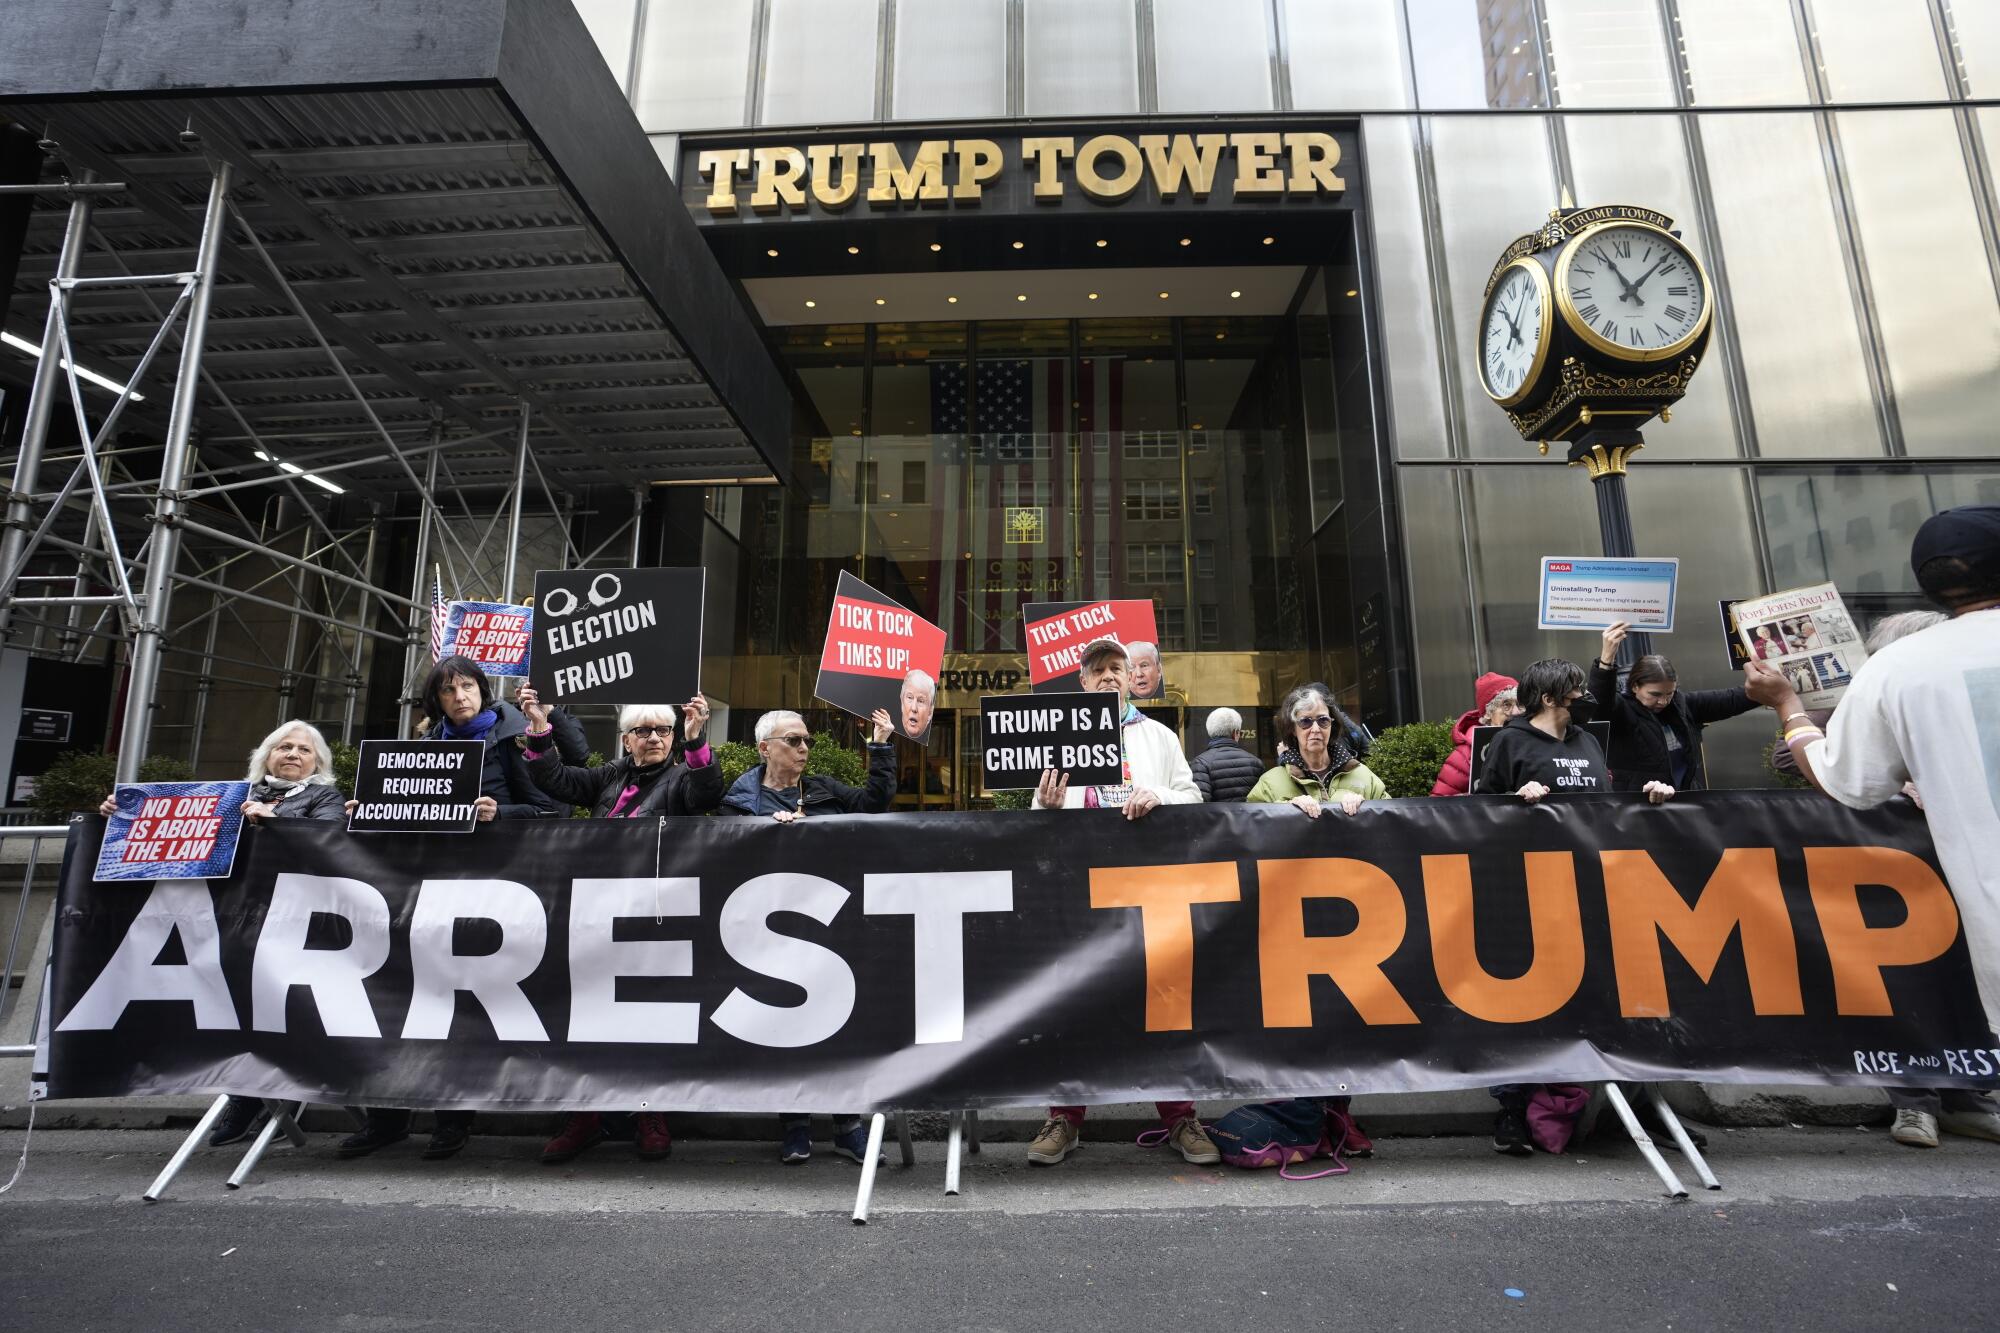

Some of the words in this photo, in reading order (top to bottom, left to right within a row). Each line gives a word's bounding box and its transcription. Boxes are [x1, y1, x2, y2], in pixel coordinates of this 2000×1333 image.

[699, 139, 1003, 215] TRUMP
[1022, 132, 1346, 203] TOWER
[1568, 208, 1613, 229] TRUMP
[1619, 207, 1666, 227] TOWER
[1506, 237, 1530, 259] TOWER
[1549, 564, 1571, 572] MAGA
[1550, 586, 1592, 594] Uninstalling
[1594, 587, 1617, 595] Trump
[1738, 607, 1765, 623] POPE
[1767, 602, 1798, 614] JOHN
[1798, 596, 1824, 607] PAUL
[1824, 591, 1835, 601] II
[462, 613, 487, 631] NO
[489, 615, 525, 633] ONE
[546, 600, 657, 655] ELECTION
[838, 603, 872, 632] TICK
[876, 610, 914, 638] TOCK
[1030, 622, 1071, 646] TICK
[1070, 604, 1116, 632] TOCK
[456, 629, 471, 645] IS
[473, 630, 530, 648] ABOVE
[456, 645, 482, 662] THE
[484, 646, 525, 664] LAW
[838, 641, 882, 669] TIMES
[886, 648, 910, 672] UP!
[554, 651, 634, 697] FRAUD
[987, 708, 1064, 734] TRUMP
[1071, 708, 1093, 731] IS
[1099, 707, 1114, 730] A
[377, 752, 464, 770] DEMOCRACY
[986, 745, 1055, 772] CRIME
[1062, 743, 1119, 769] BOSS
[1552, 758, 1590, 769] TRUMP
[1556, 776, 1597, 788] GUILTY
[1569, 767, 1581, 777] IS
[382, 778, 452, 796] REQUIRES
[140, 799, 170, 819] NO
[175, 797, 218, 818] ONE
[355, 803, 475, 822] ACCOUNTABILITY
[127, 820, 150, 841] IS
[152, 818, 220, 840] ABOVE
[126, 841, 163, 862] THE
[165, 840, 214, 861] LAW
[55, 870, 1014, 1048] ARREST
[1088, 846, 1959, 1033] TRUMP
[1853, 1050, 1903, 1075] RISE
[1908, 1055, 1941, 1068] AND
